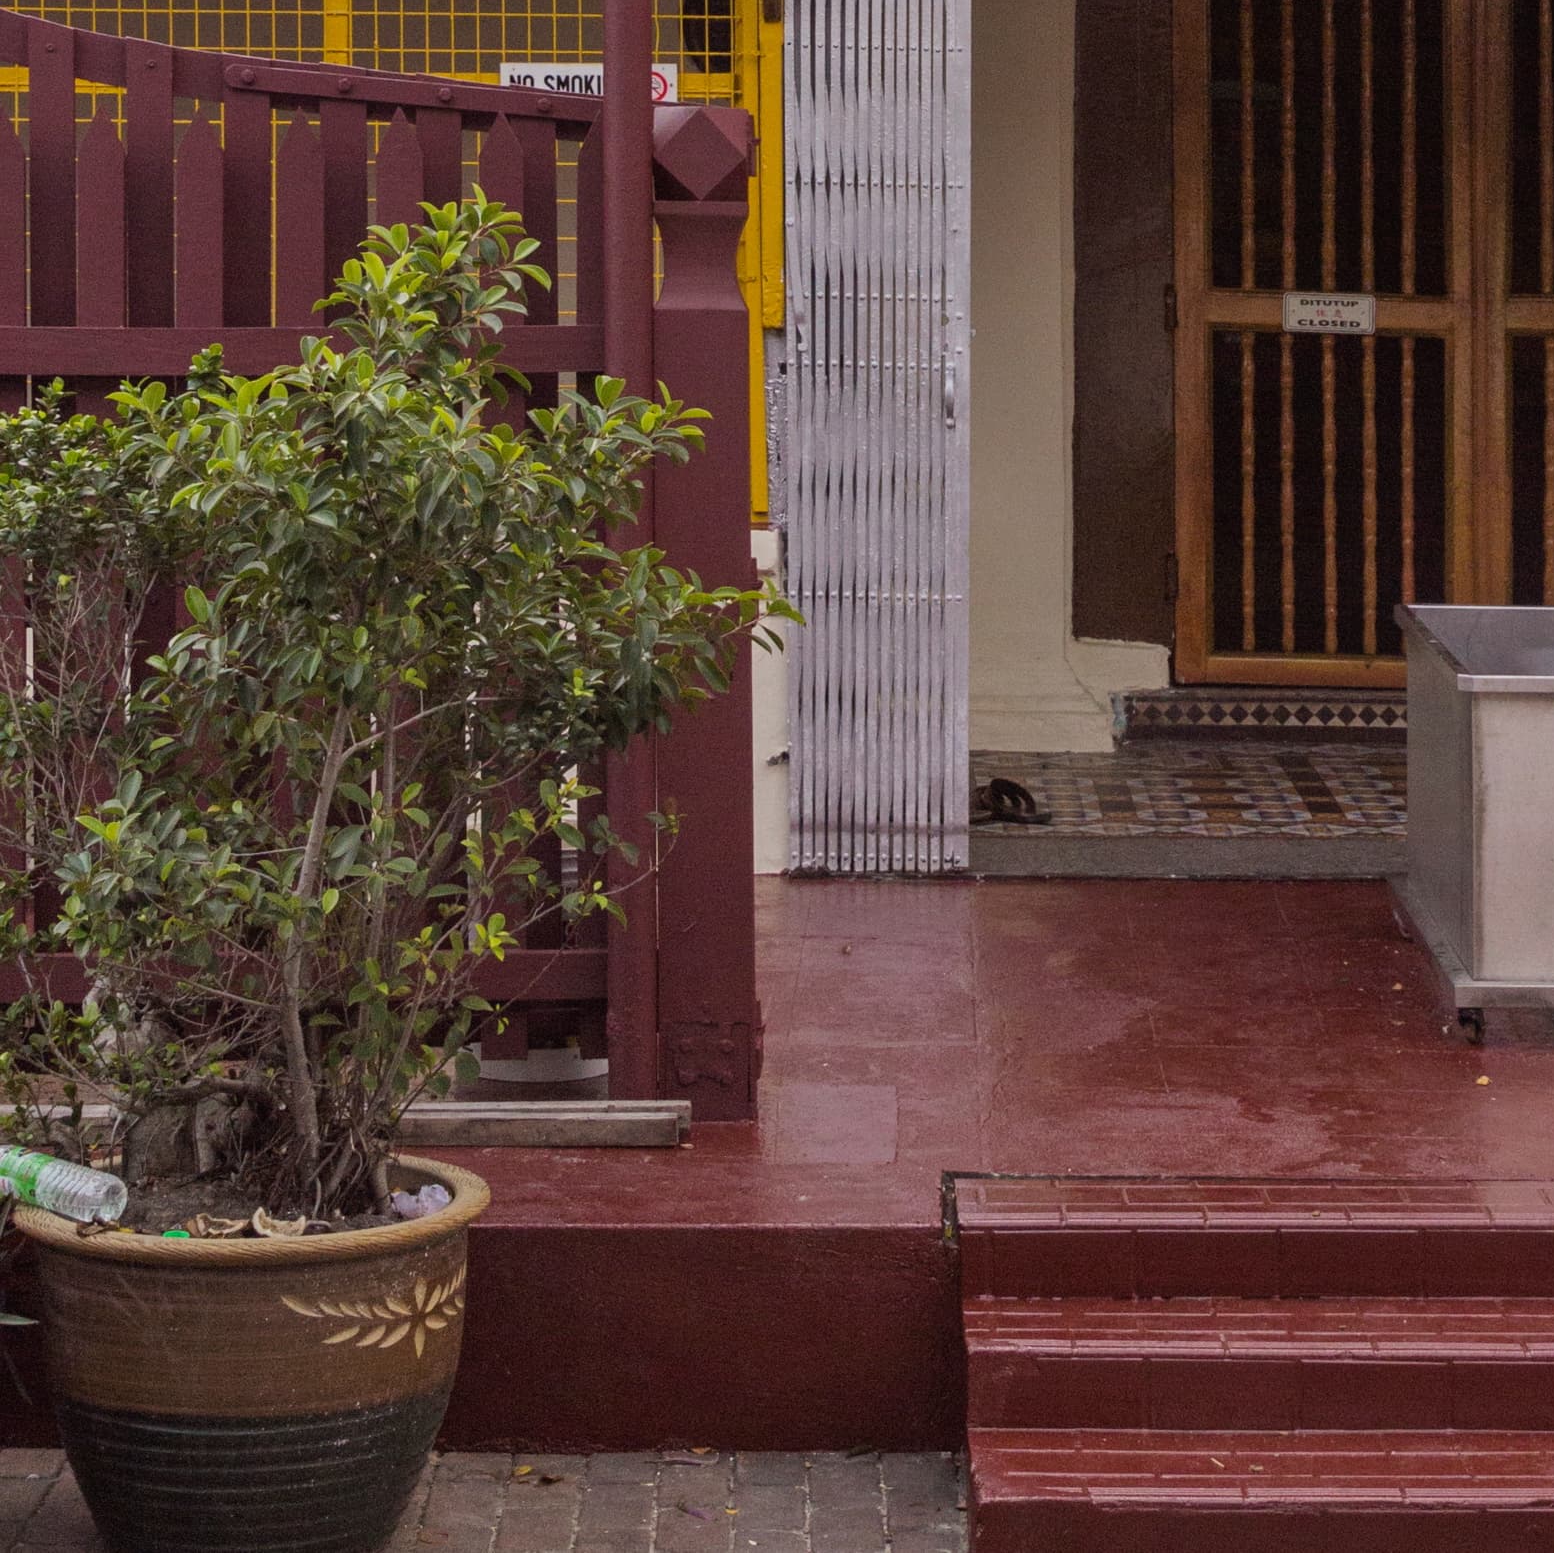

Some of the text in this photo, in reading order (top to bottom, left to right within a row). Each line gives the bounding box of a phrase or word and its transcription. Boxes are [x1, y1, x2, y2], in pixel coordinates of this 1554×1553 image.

[544, 74, 604, 96] SMOKI
[1300, 299, 1359, 307] DITUTUP
[1297, 318, 1361, 328] CLOSED
